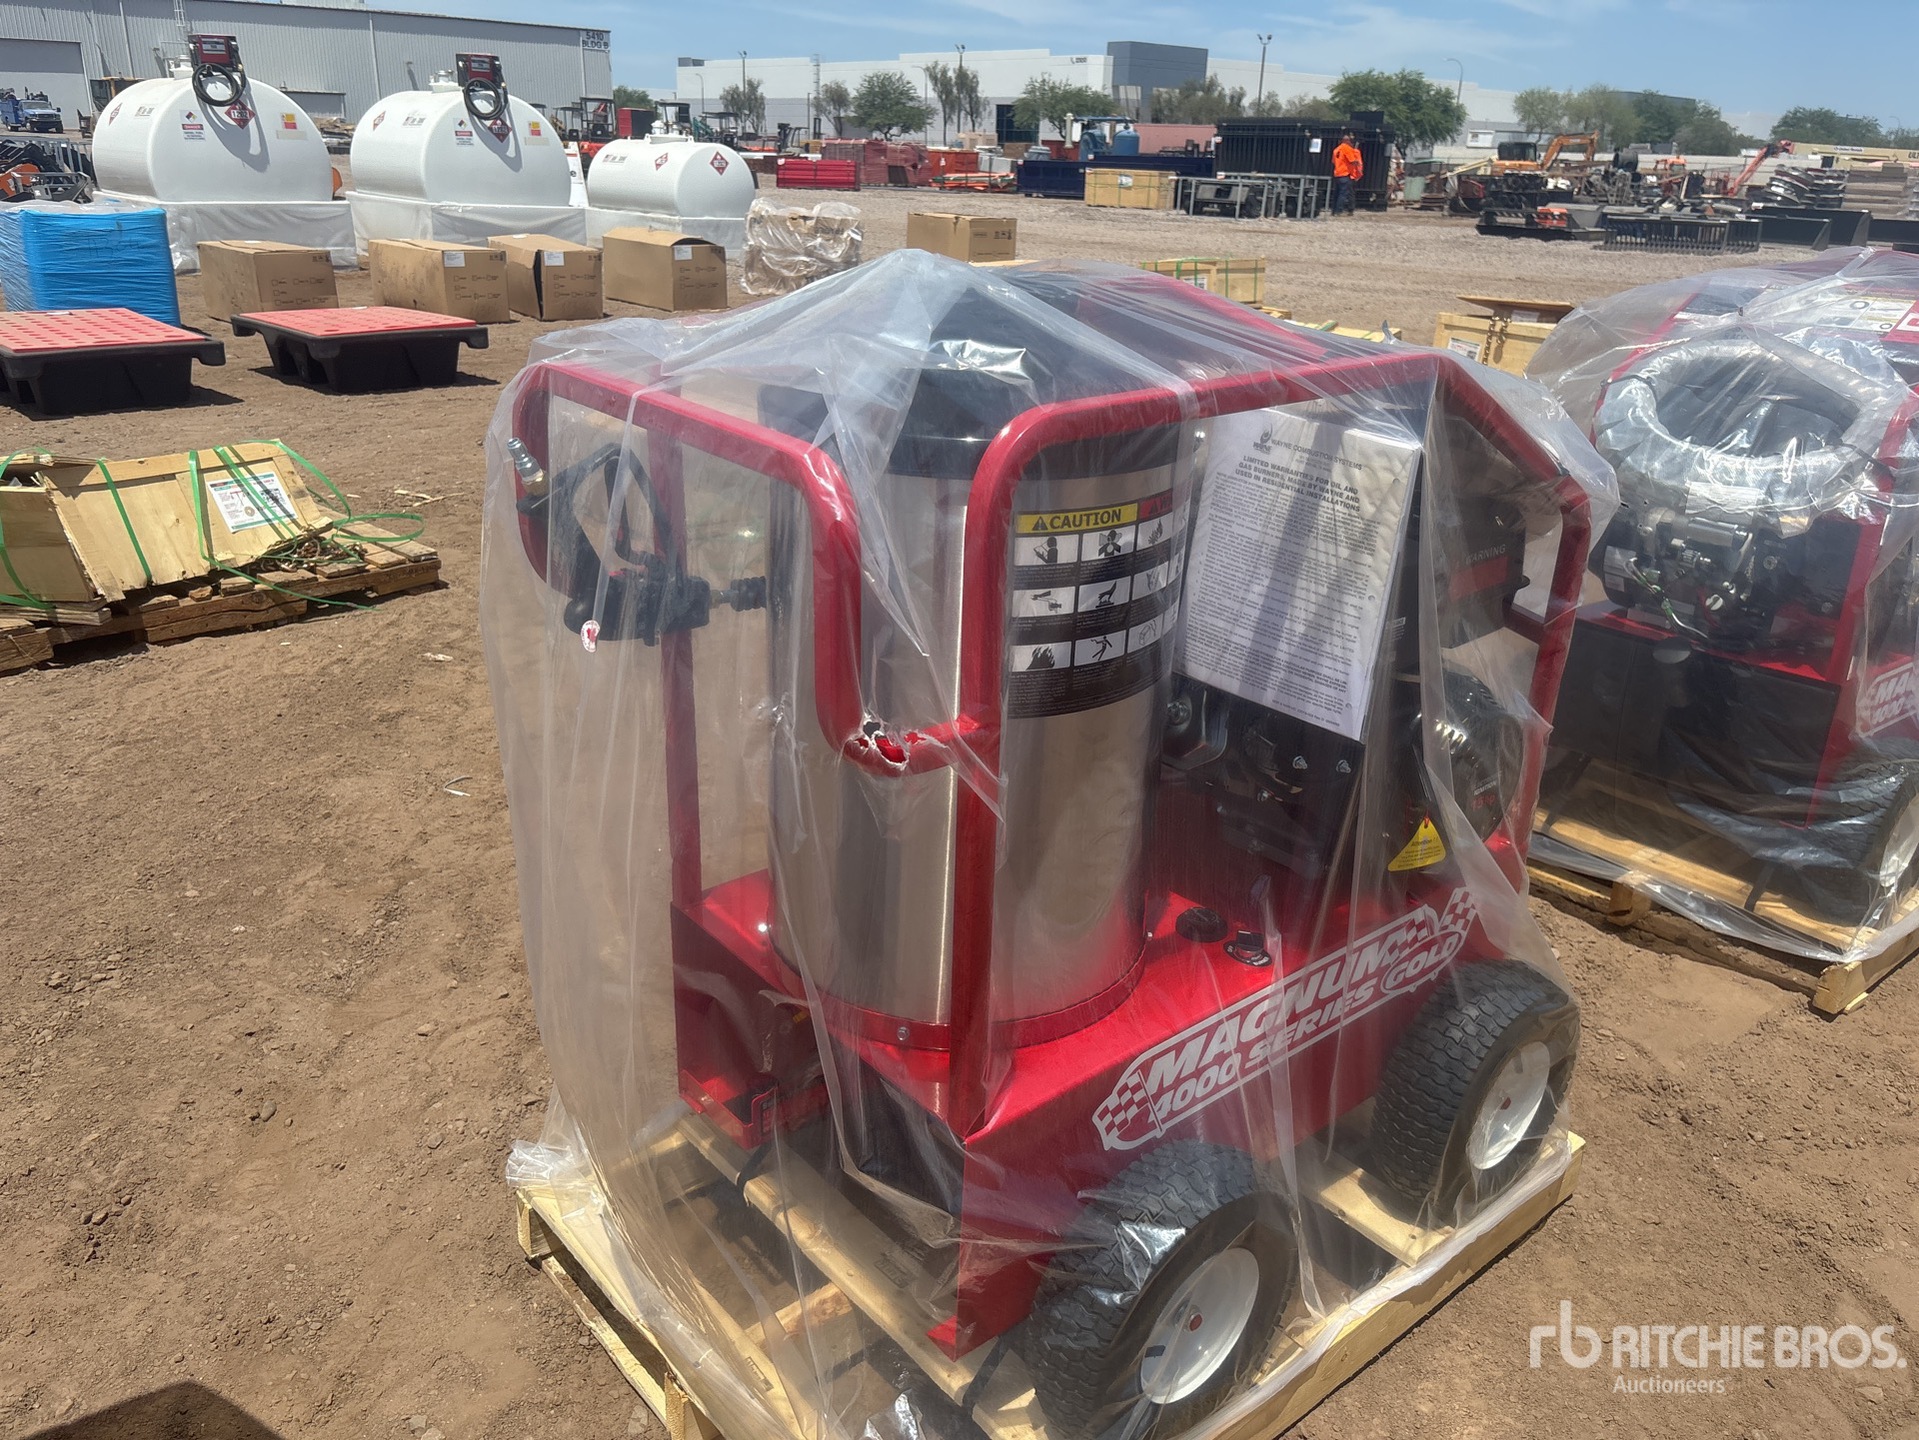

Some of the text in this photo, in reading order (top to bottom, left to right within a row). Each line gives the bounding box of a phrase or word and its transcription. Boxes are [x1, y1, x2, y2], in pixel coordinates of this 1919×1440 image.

[586, 31, 604, 41] 5410
[1243, 455, 1269, 469] LIMITED
[1269, 462, 1314, 481] WARRANTIES
[1314, 475, 1330, 486] FOR
[1330, 480, 1343, 490] OIL
[1343, 485, 1359, 496] AND
[1271, 438, 1292, 450] WAYNE
[1292, 443, 1333, 461] COMBUSTION
[1333, 456, 1363, 471] SYSTEMS
[1234, 468, 1361, 513] USED IN RESIDENTIAL INSTALLATIONS
[1238, 461, 1361, 504] GAS BURNERS, MADE BY WAYNE AND
[1049, 508, 1122, 531] CAUTION
[1383, 932, 1465, 992] GOLD
[1150, 926, 1408, 1093] MAGNUM
[1147, 977, 1377, 1123] 4000 SERIES
